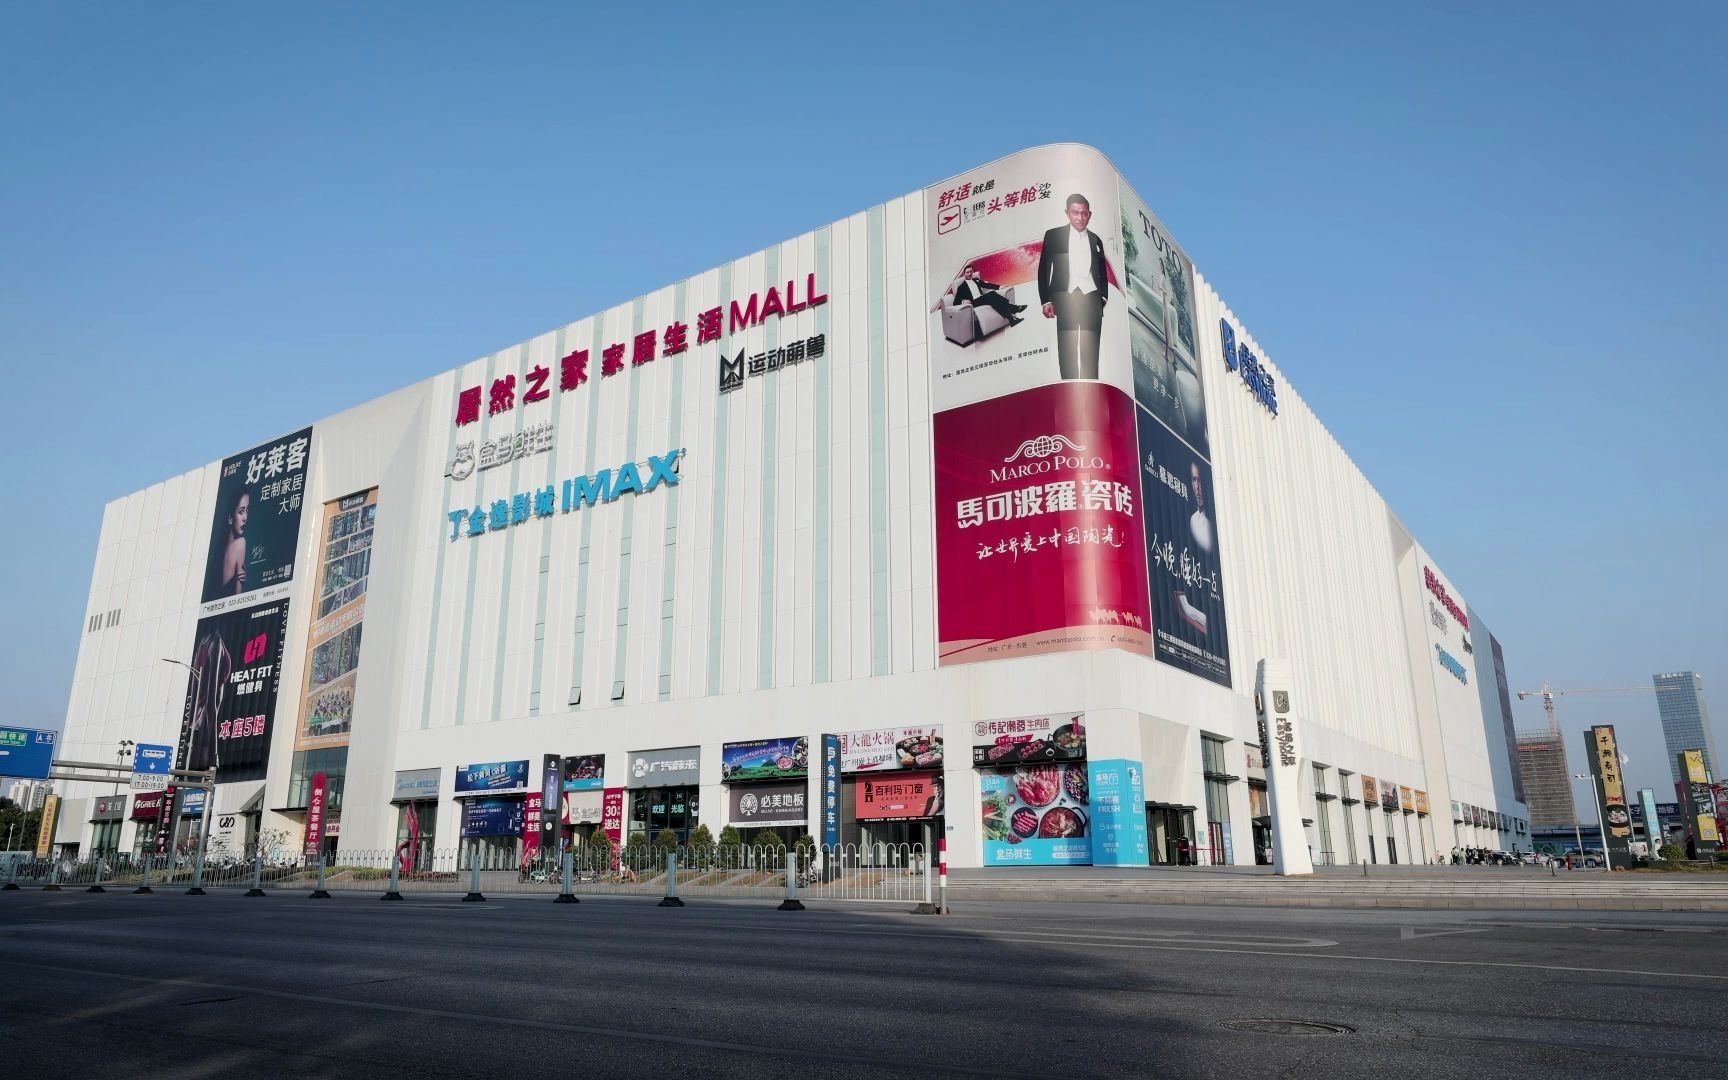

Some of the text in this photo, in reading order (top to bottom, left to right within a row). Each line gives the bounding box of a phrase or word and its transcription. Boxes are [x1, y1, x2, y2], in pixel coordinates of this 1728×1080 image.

[988, 186, 1037, 214] 头等舱
[1138, 210, 1182, 276] TOTO
[746, 333, 826, 376] 运动萌兽
[456, 348, 588, 427] 居然之家
[478, 420, 554, 471] 盒马鲜生
[244, 438, 308, 484] 好莱客
[990, 454, 1104, 483] MARCO POLO
[260, 474, 302, 501] 定制家居
[562, 450, 679, 514] IMAX
[278, 493, 302, 514] 大师
[230, 665, 274, 684] HEAT FIT
[219, 715, 266, 740] 本座5楼
[828, 747, 836, 762] P
[760, 793, 804, 808] 必美地板
[828, 764, 836, 824] 免费停车
[876, 784, 923, 796] 百利玛门窗
[140, 800, 156, 808] GREE
[606, 805, 616, 816] 30
[652, 804, 664, 814] 欢迎
[670, 804, 684, 814] 光临
[527, 822, 540, 832] 生活
[604, 818, 620, 830] 送达
[996, 848, 1032, 860] 盒马鲜生
